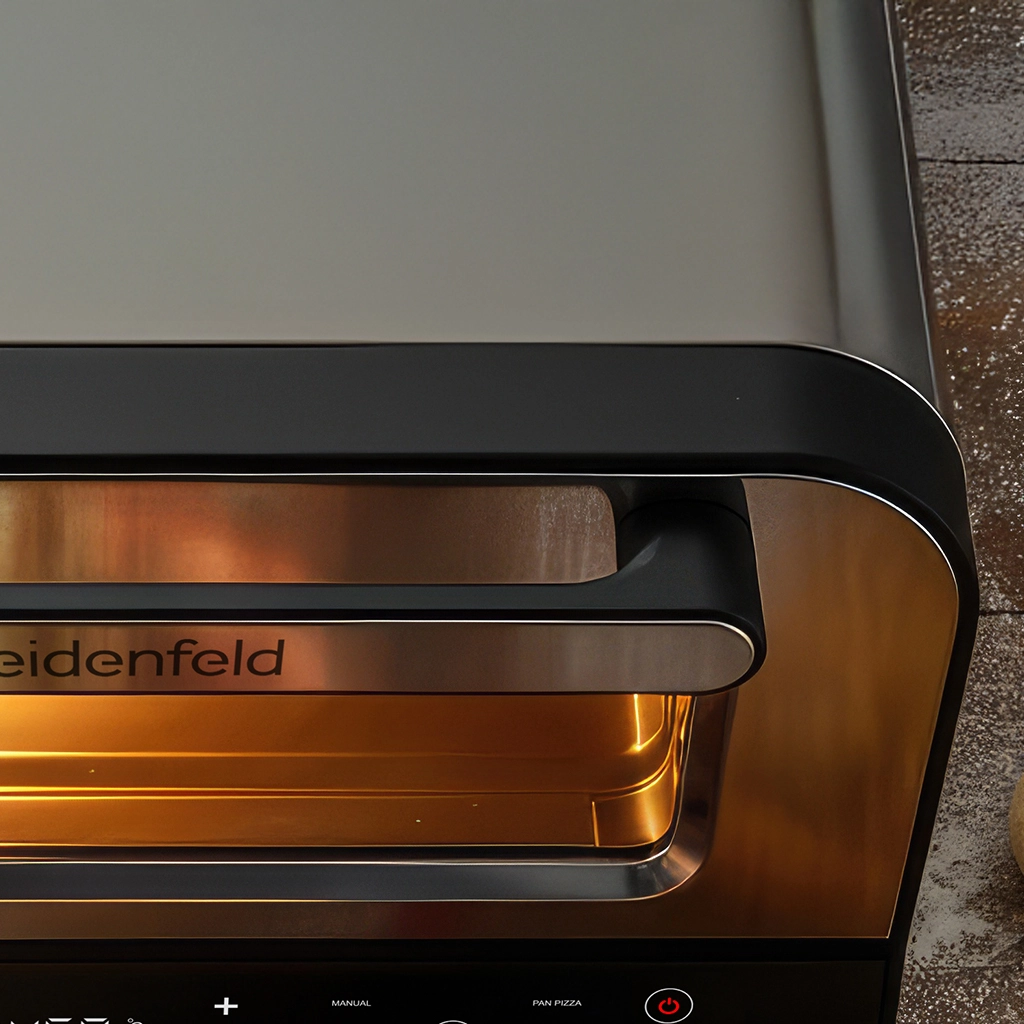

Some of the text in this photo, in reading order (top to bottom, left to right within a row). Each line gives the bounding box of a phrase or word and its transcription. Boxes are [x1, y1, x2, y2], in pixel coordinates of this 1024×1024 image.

[331, 999, 372, 1007] MANUAL
[532, 999, 582, 1007] PAN PIZZA
